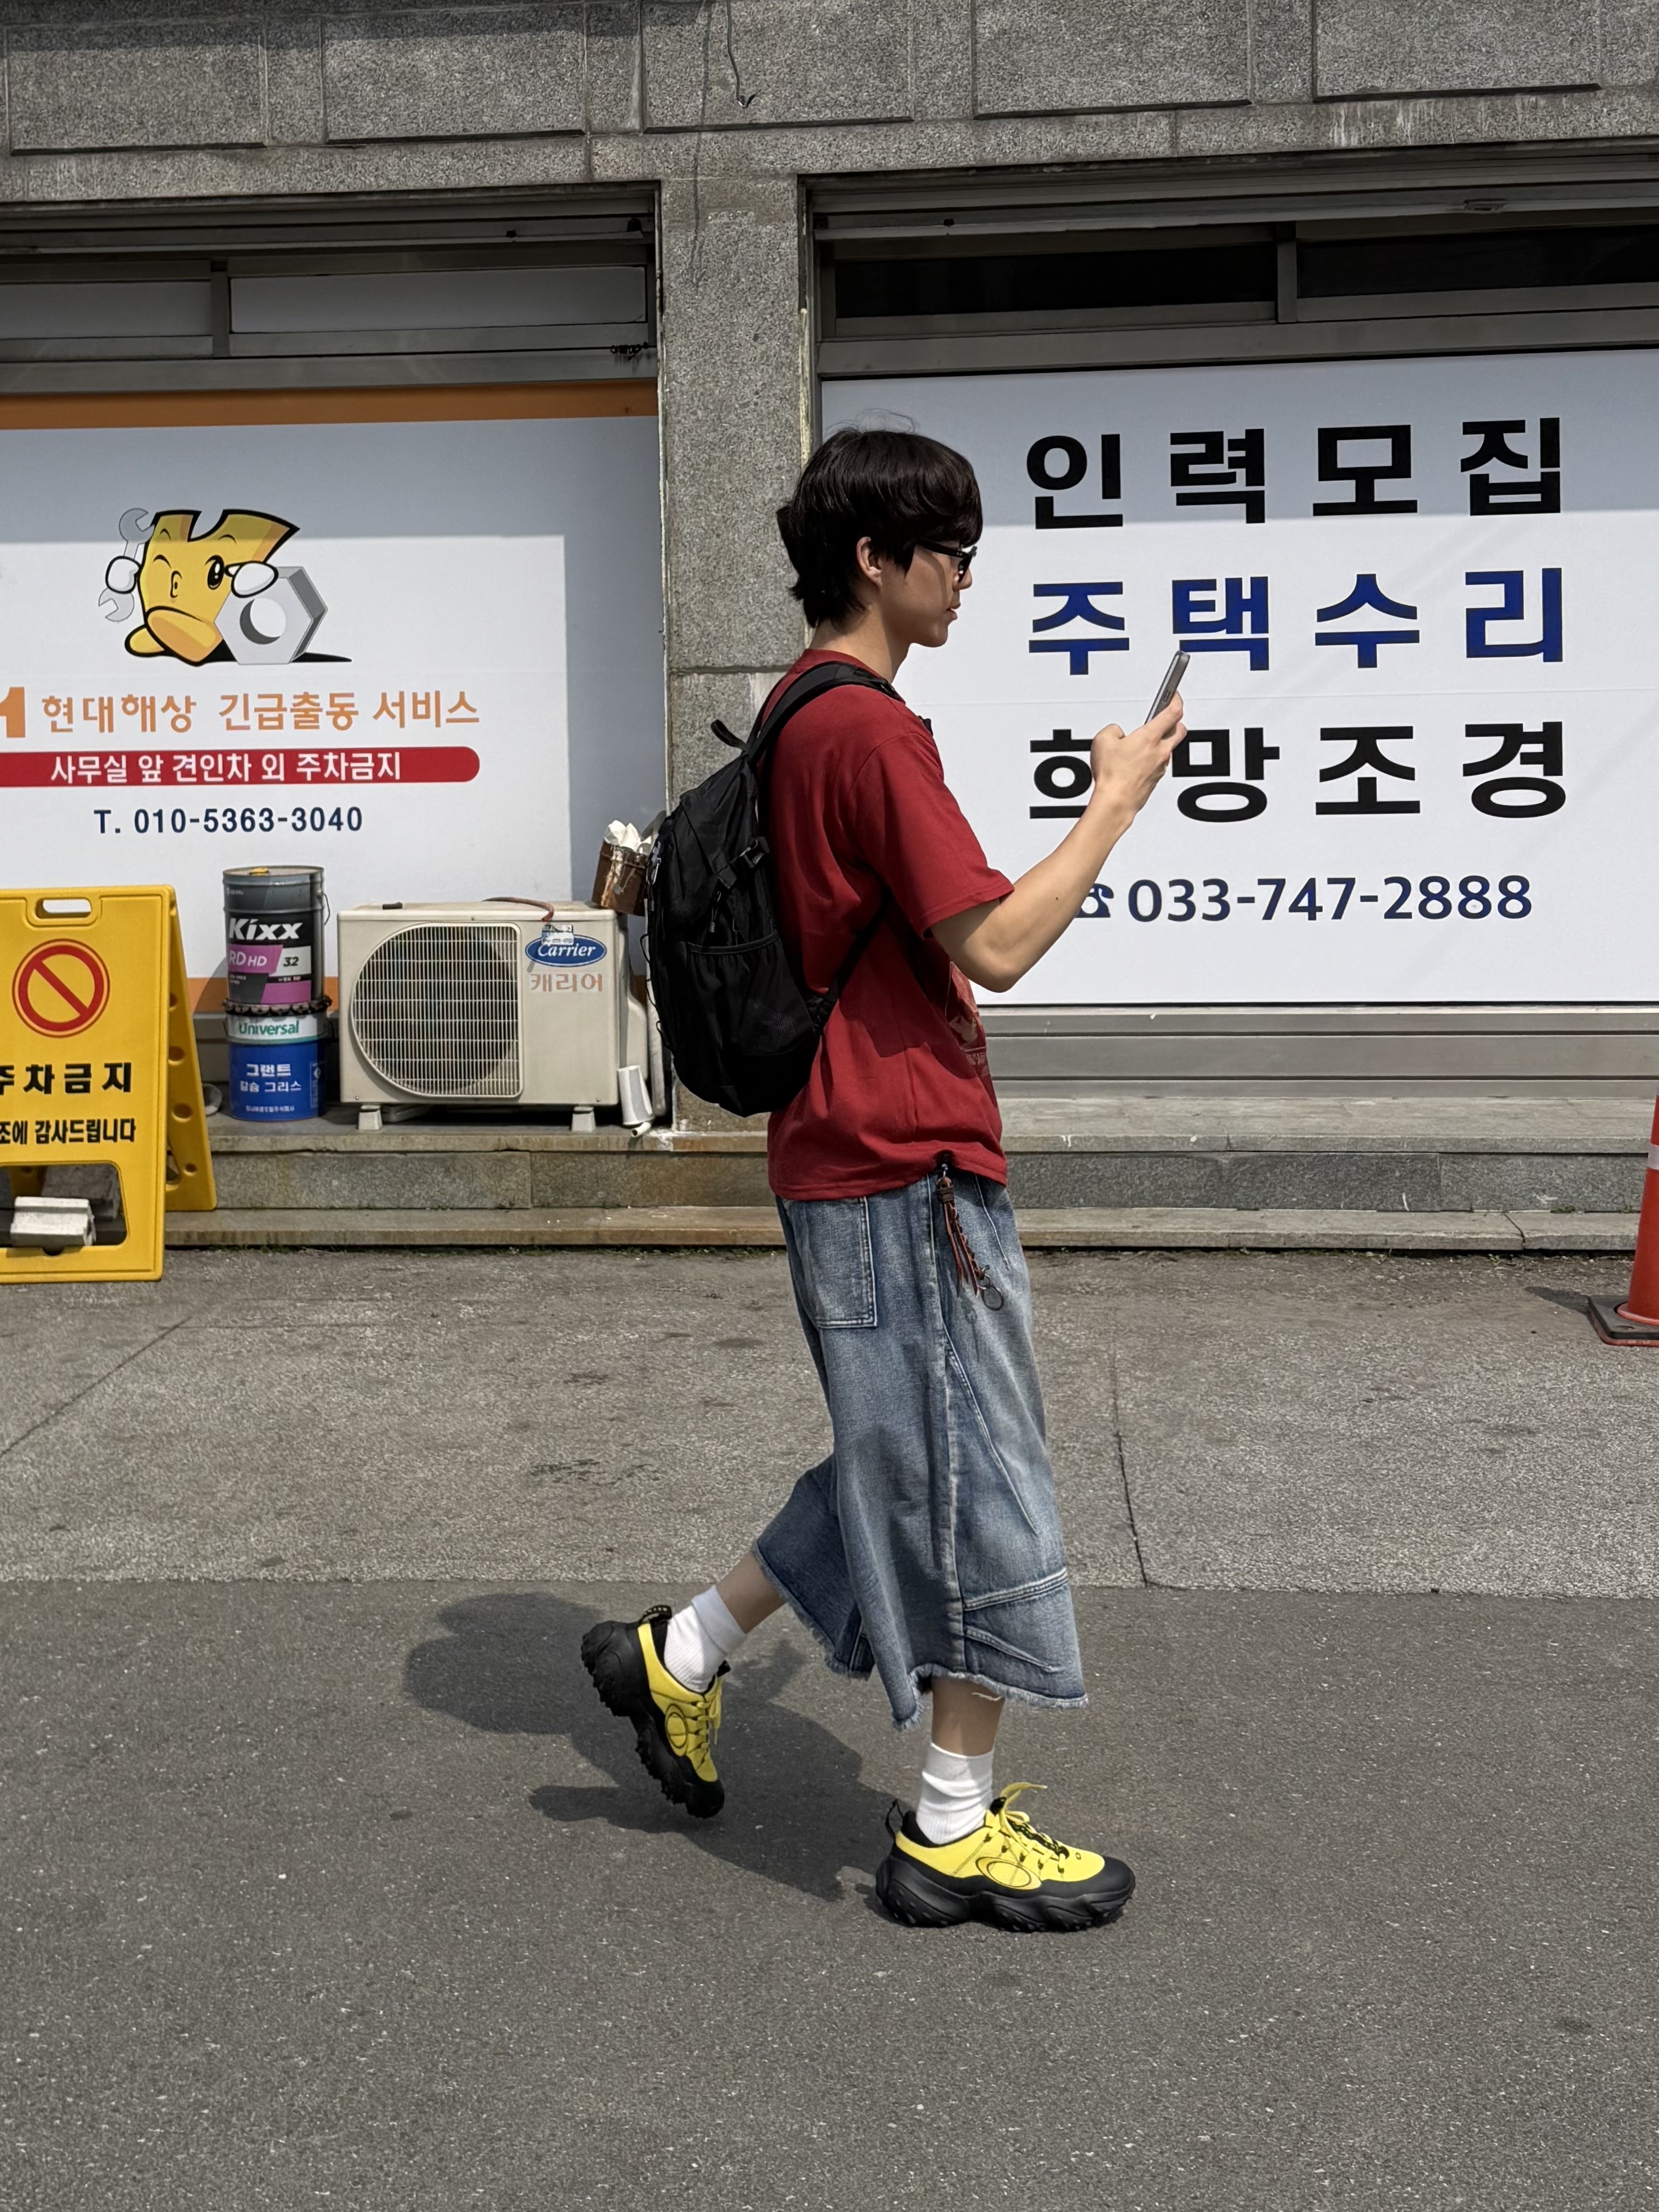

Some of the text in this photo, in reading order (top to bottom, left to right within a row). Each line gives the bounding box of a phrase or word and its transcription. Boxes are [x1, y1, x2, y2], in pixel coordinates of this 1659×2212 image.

[1026, 417, 1561, 529] 인력모집
[1029, 568, 1564, 675] 주택수리
[43, 695, 197, 733] 현대해상
[219, 692, 359, 731] 긴급출동
[373, 691, 480, 728] 서비스
[51, 752, 401, 784] 사무실 앞 견인차 외 주차금지
[93, 806, 363, 834] T. 010-5363-3040
[1128, 875, 1533, 922] 033-747-2888
[229, 918, 303, 940] Kixx
[229, 950, 267, 966] RD HD
[283, 956, 300, 967] 32
[538, 943, 596, 956] Carrier
[531, 974, 602, 992] 캐리어
[240, 1021, 300, 1035] Universal
[264, 1081, 302, 1092] 그리스
[35, 1118, 136, 1144] 감사드립니다
